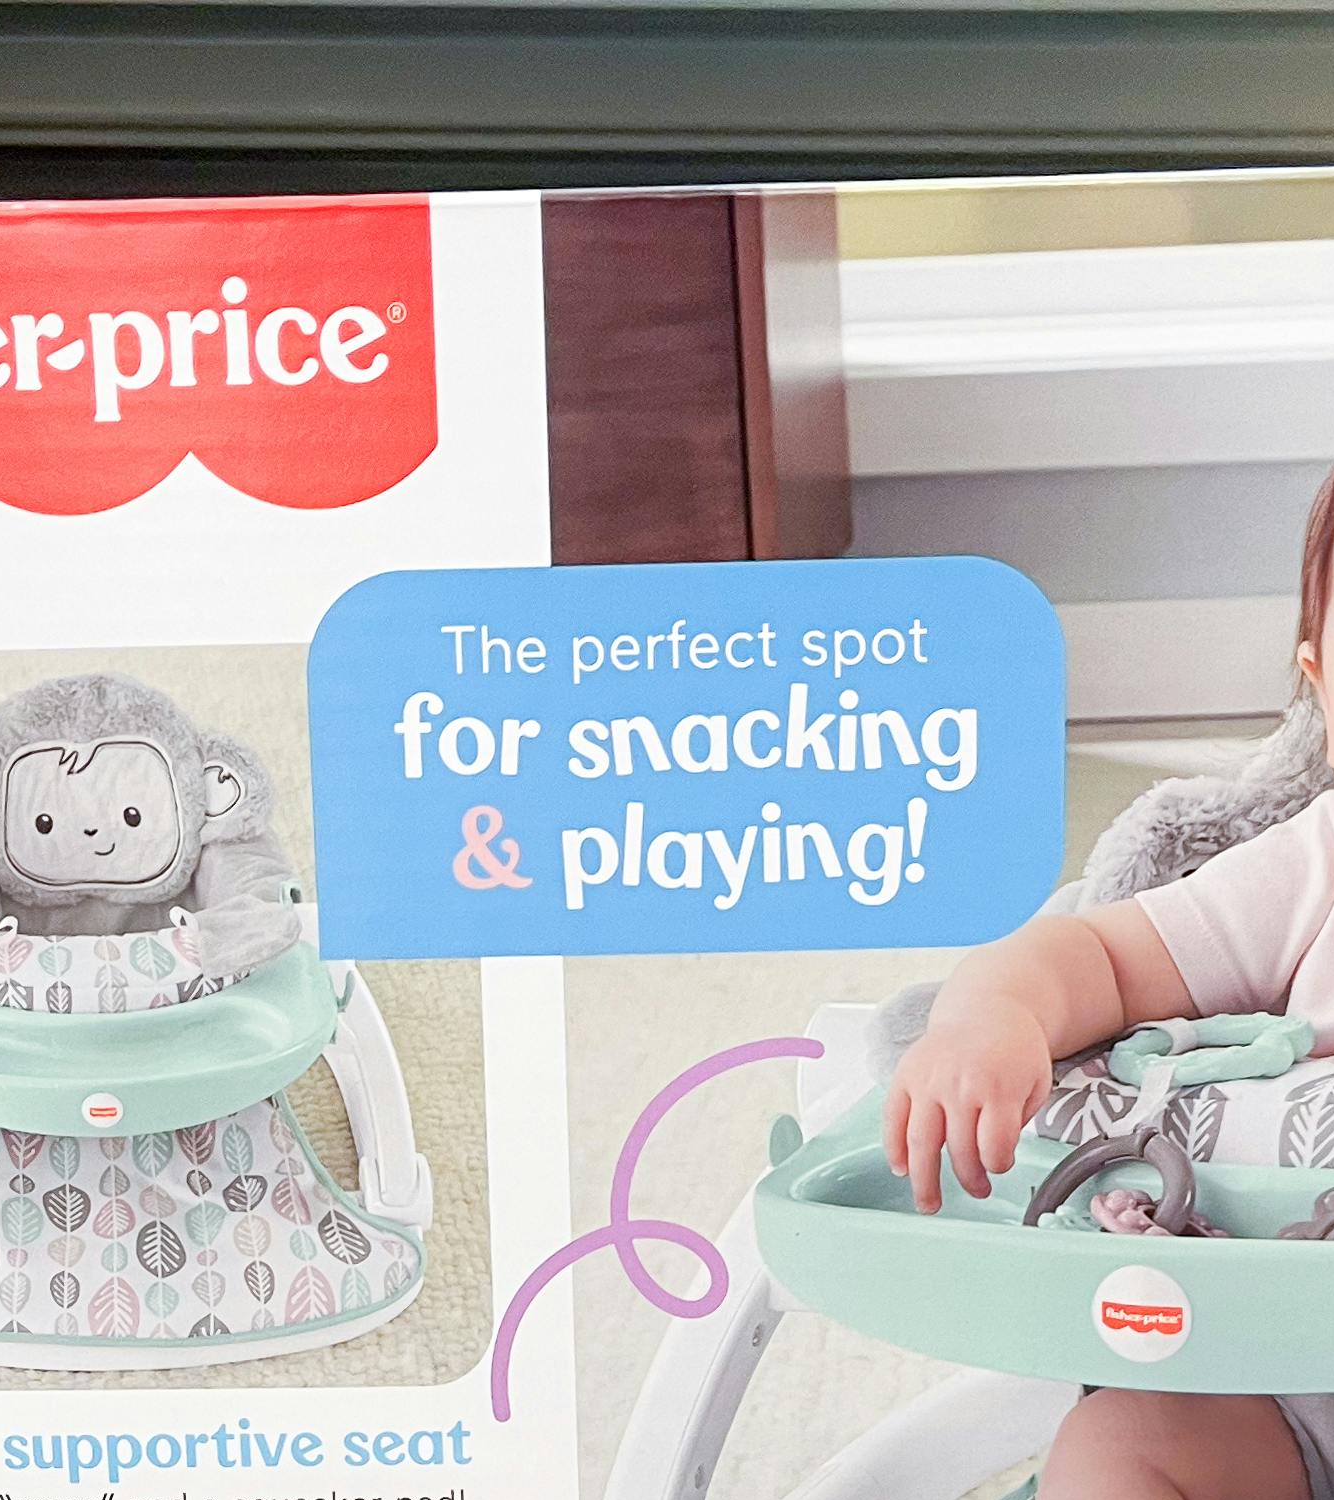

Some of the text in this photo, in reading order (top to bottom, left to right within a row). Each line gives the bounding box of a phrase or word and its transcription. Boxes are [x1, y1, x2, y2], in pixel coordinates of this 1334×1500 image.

[441, 618, 929, 685] The perfect spot
[393, 682, 979, 792] for snacking
[451, 797, 928, 911] & playing!
[2, 1417, 325, 1483] supportive
[342, 1419, 473, 1468] seat
